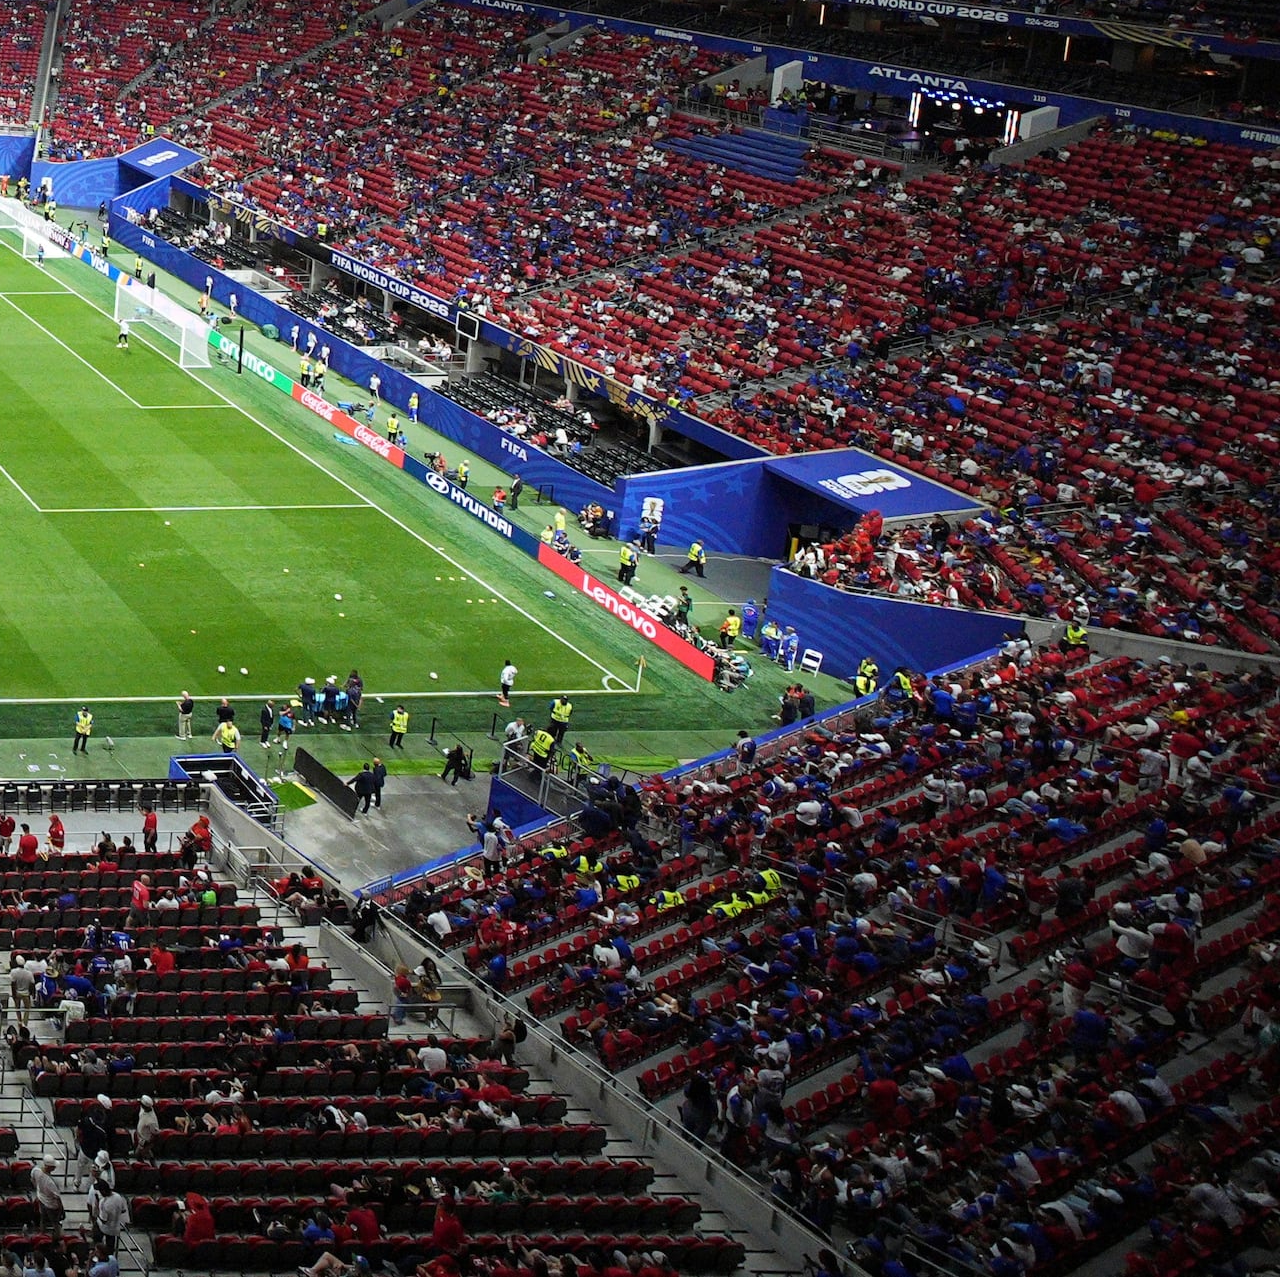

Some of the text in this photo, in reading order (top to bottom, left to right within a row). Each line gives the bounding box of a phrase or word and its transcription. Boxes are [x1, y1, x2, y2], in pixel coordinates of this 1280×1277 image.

[927, 1, 956, 16] CUP
[956, 6, 1010, 23] 2026
[1025, 17, 1060, 29] 224-225
[868, 65, 969, 92] ATLANTA
[141, 234, 156, 249] FIFA
[90, 256, 110, 276] VISA
[331, 253, 449, 317] FIFA WORLD CUP 2026
[219, 337, 275, 383] aramco
[300, 388, 333, 422] Coca-Cola
[353, 423, 390, 459] Coca-Cola
[500, 436, 528, 462] FIFA
[450, 485, 513, 538] HYUNDAI
[582, 574, 657, 639] Lenovo
[118, 940, 128, 950] 10
